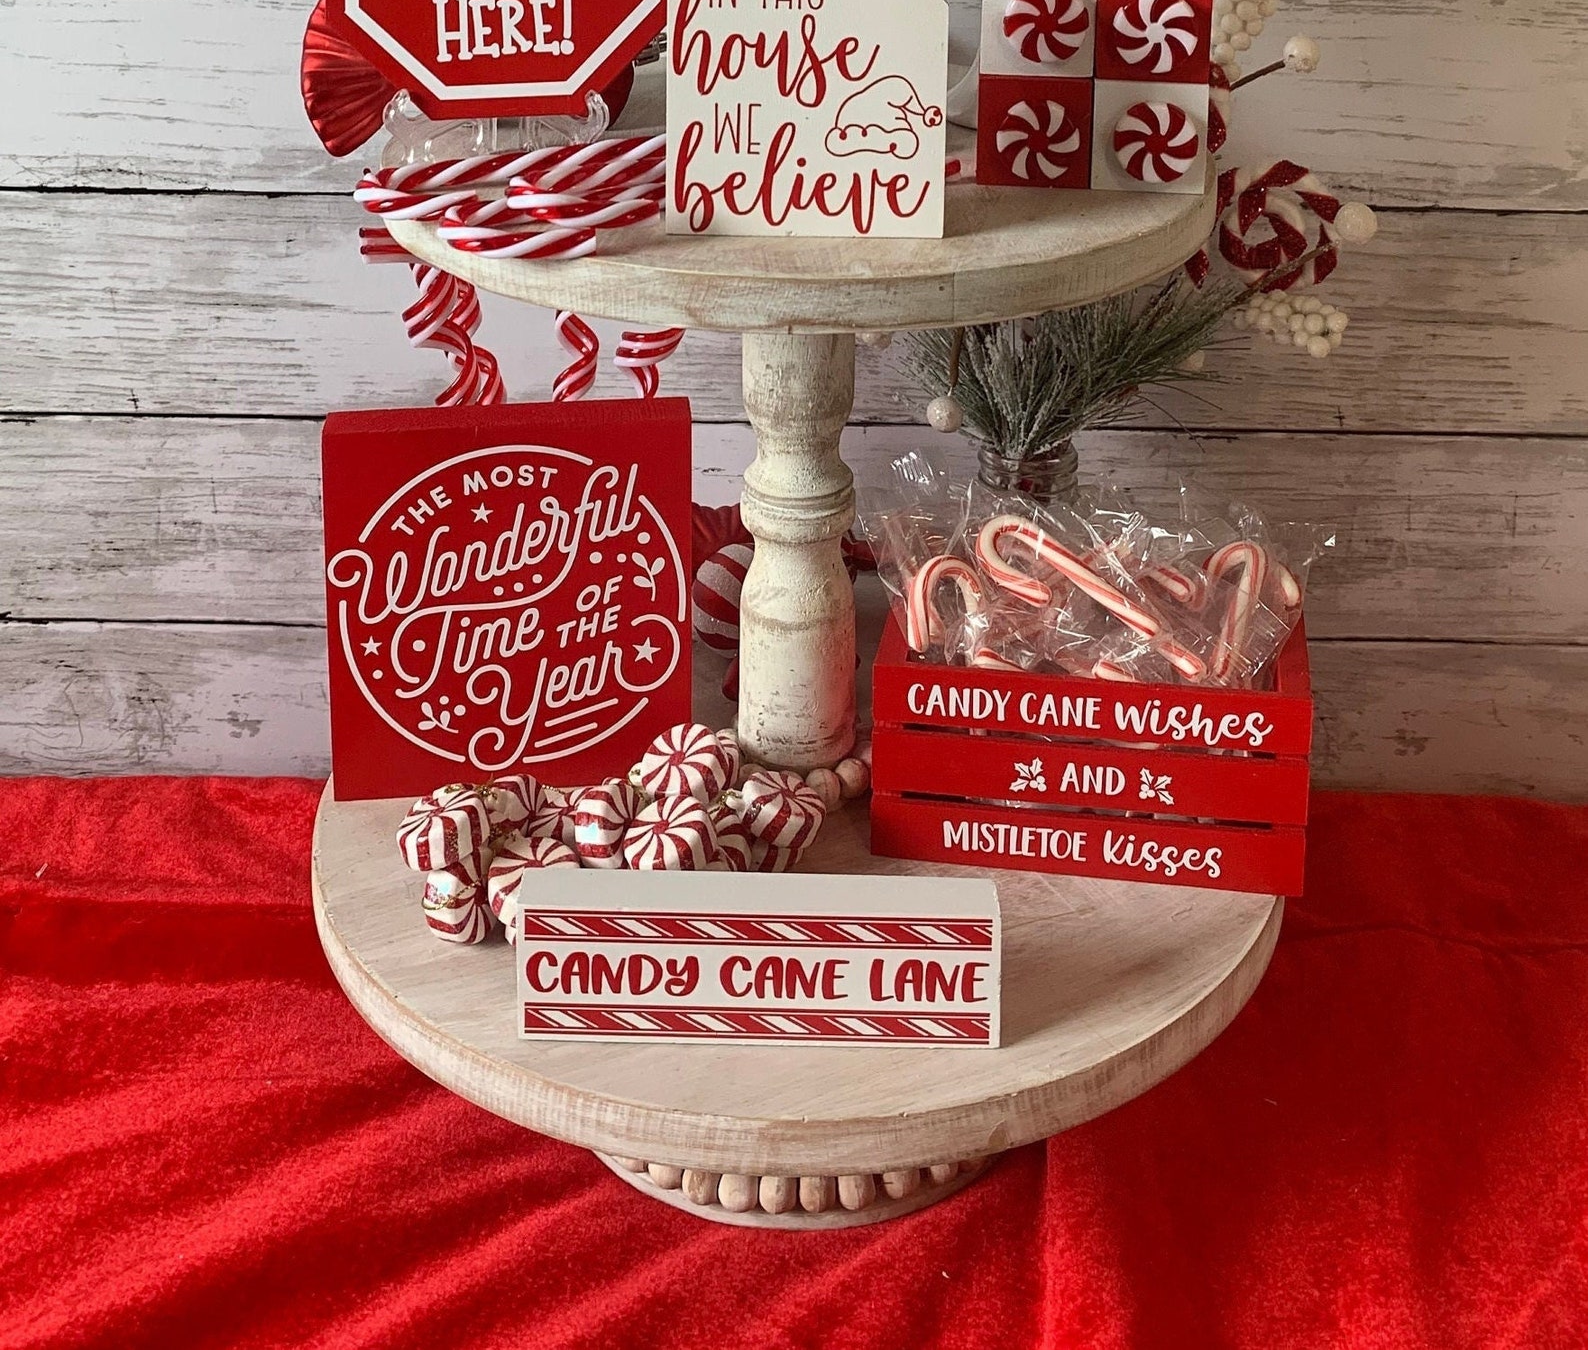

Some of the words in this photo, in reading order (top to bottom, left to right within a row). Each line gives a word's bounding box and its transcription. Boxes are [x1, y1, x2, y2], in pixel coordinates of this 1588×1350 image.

[714, 102, 762, 155] WE
[674, 120, 930, 235] believe
[391, 485, 453, 536] THE
[463, 465, 558, 496] MOST
[327, 463, 642, 625] Wonderful
[576, 574, 623, 613] OF
[391, 603, 545, 699] Time
[556, 604, 622, 649] THE
[466, 614, 681, 772] Year
[907, 682, 1012, 722] CANDY
[1019, 692, 1102, 729] CANE
[1060, 762, 1126, 796] AND
[943, 820, 1087, 862] MISTLETOE
[526, 951, 700, 996] CANDY
[719, 956, 849, 1000] CANE
[869, 958, 990, 1003] LANE
